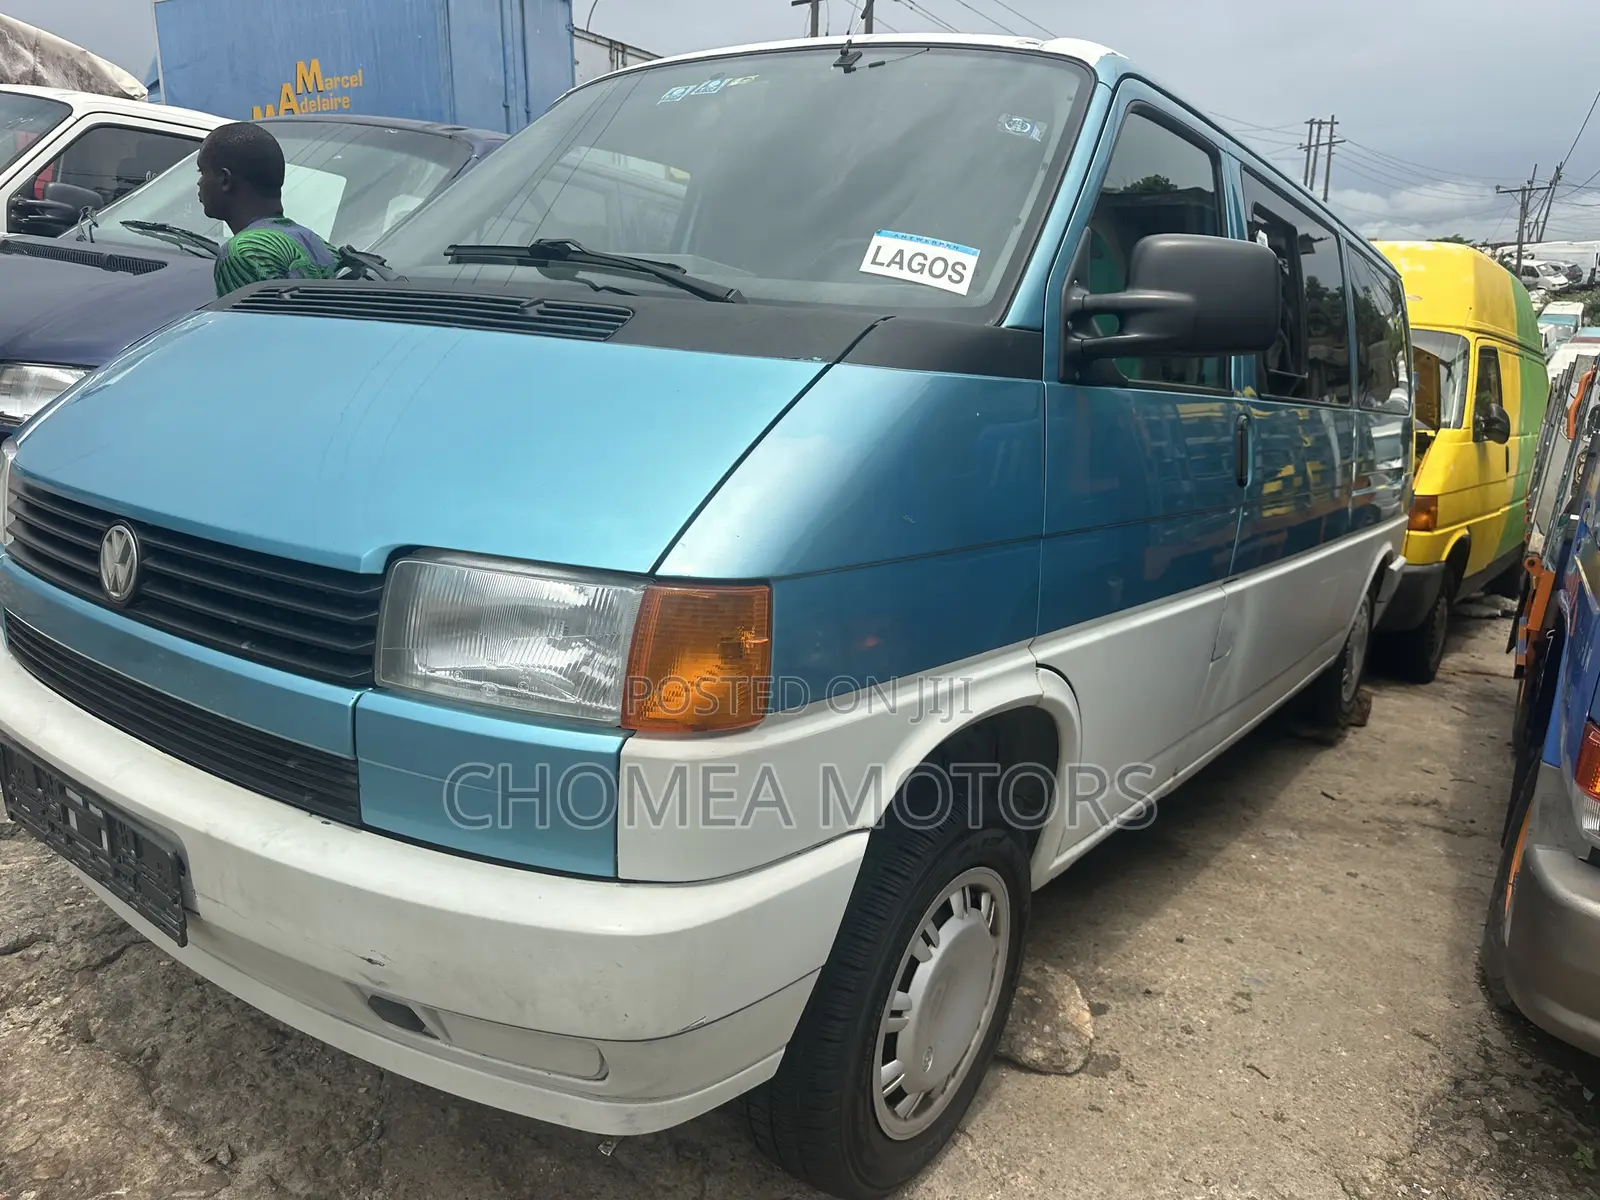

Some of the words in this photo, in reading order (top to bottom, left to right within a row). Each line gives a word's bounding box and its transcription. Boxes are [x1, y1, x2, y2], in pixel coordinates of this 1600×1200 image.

[296, 58, 363, 95] Marcel
[278, 82, 350, 116] Adelaire
[894, 233, 960, 250] ANTWERPEN
[870, 245, 967, 284] LAGOS
